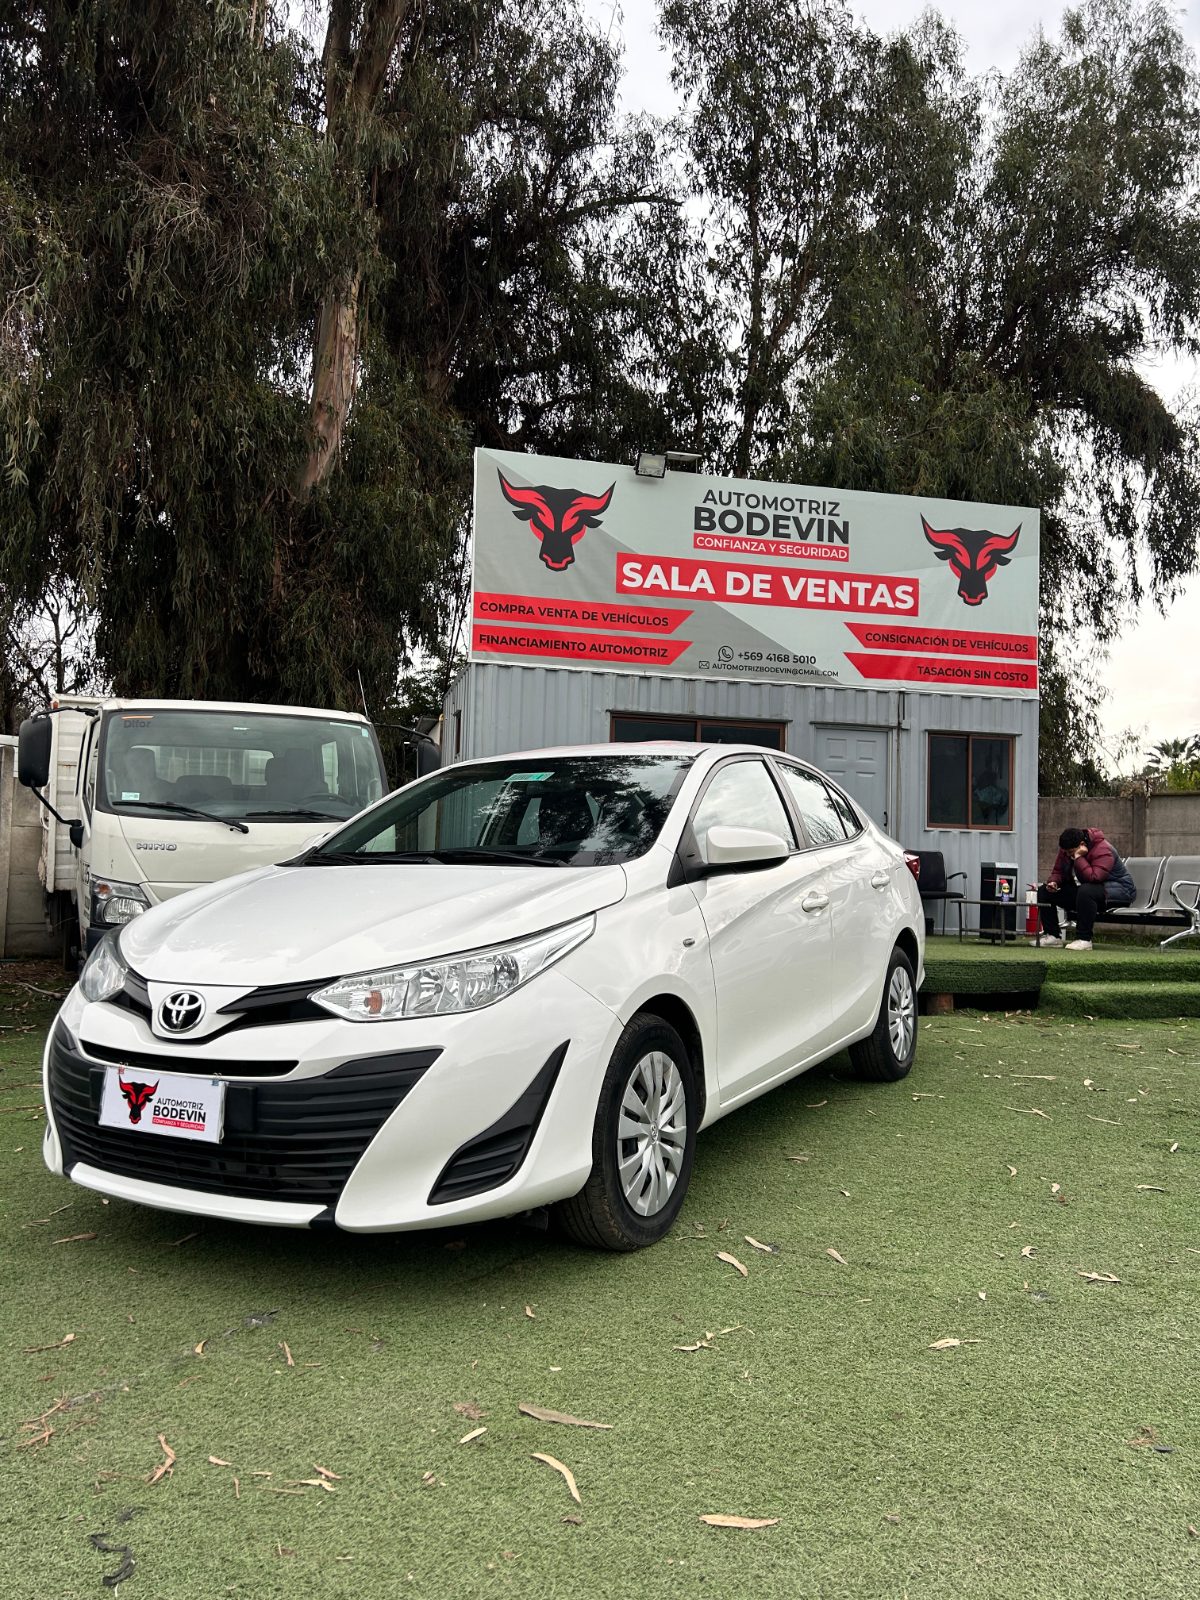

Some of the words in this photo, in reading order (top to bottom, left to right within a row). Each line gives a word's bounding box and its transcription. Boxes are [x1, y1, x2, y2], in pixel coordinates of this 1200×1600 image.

[702, 489, 840, 517] AUTOMOTRIZ
[694, 506, 849, 544] BODEVIN
[696, 536, 766, 552] CONFIANZA
[769, 543, 777, 552] Y
[779, 544, 848, 559] SEGURIDAD
[621, 561, 715, 594] SALA
[725, 570, 772, 598] DE
[781, 575, 915, 610] VENTAS
[479, 601, 535, 616] COMPRA
[538, 606, 578, 619] VENTA
[581, 610, 598, 621] DE
[601, 612, 669, 627] VEHÍCULOS
[479, 633, 587, 652] FINANCIAMIENTO
[589, 643, 669, 658] AUTOMOTRIZ
[865, 632, 949, 647] CONSIGNACIÓN
[952, 639, 967, 648] DE
[969, 639, 1029, 653] VEHÍCULOS
[738, 651, 763, 661] +569
[766, 653, 790, 663] 4168
[793, 654, 817, 665] 5010
[711, 663, 839, 677] AUTOMOTRIZBODEVIN@GMAIL.COM
[917, 665, 971, 679] TASACIÓN
[974, 669, 991, 680] SIN
[994, 671, 1029, 682] COSTO
[136, 843, 177, 851] HINO
[153, 1105, 206, 1123] BODEVIN
[157, 1098, 204, 1110] AUTOMOTRIZ
